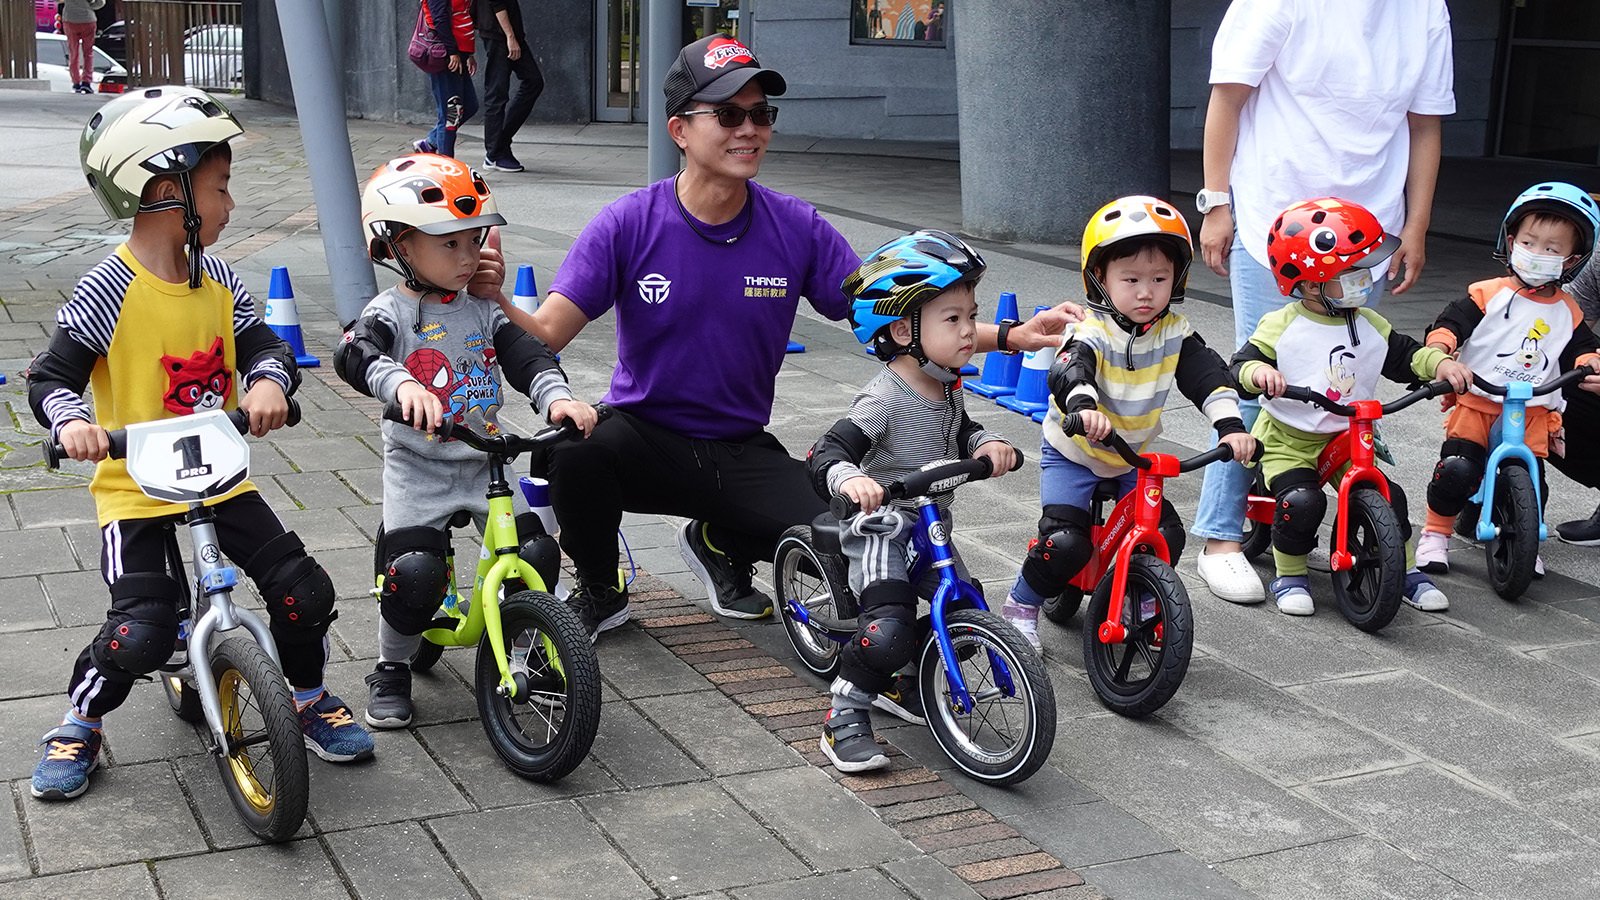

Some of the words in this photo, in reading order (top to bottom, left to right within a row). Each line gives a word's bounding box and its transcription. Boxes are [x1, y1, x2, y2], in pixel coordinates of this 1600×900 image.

[743, 276, 788, 287] THANOS
[467, 376, 493, 387] SUPER
[466, 388, 495, 400] POWER
[173, 435, 212, 479] 1
[180, 466, 208, 478] PRO
[928, 472, 971, 492] STRIDER
